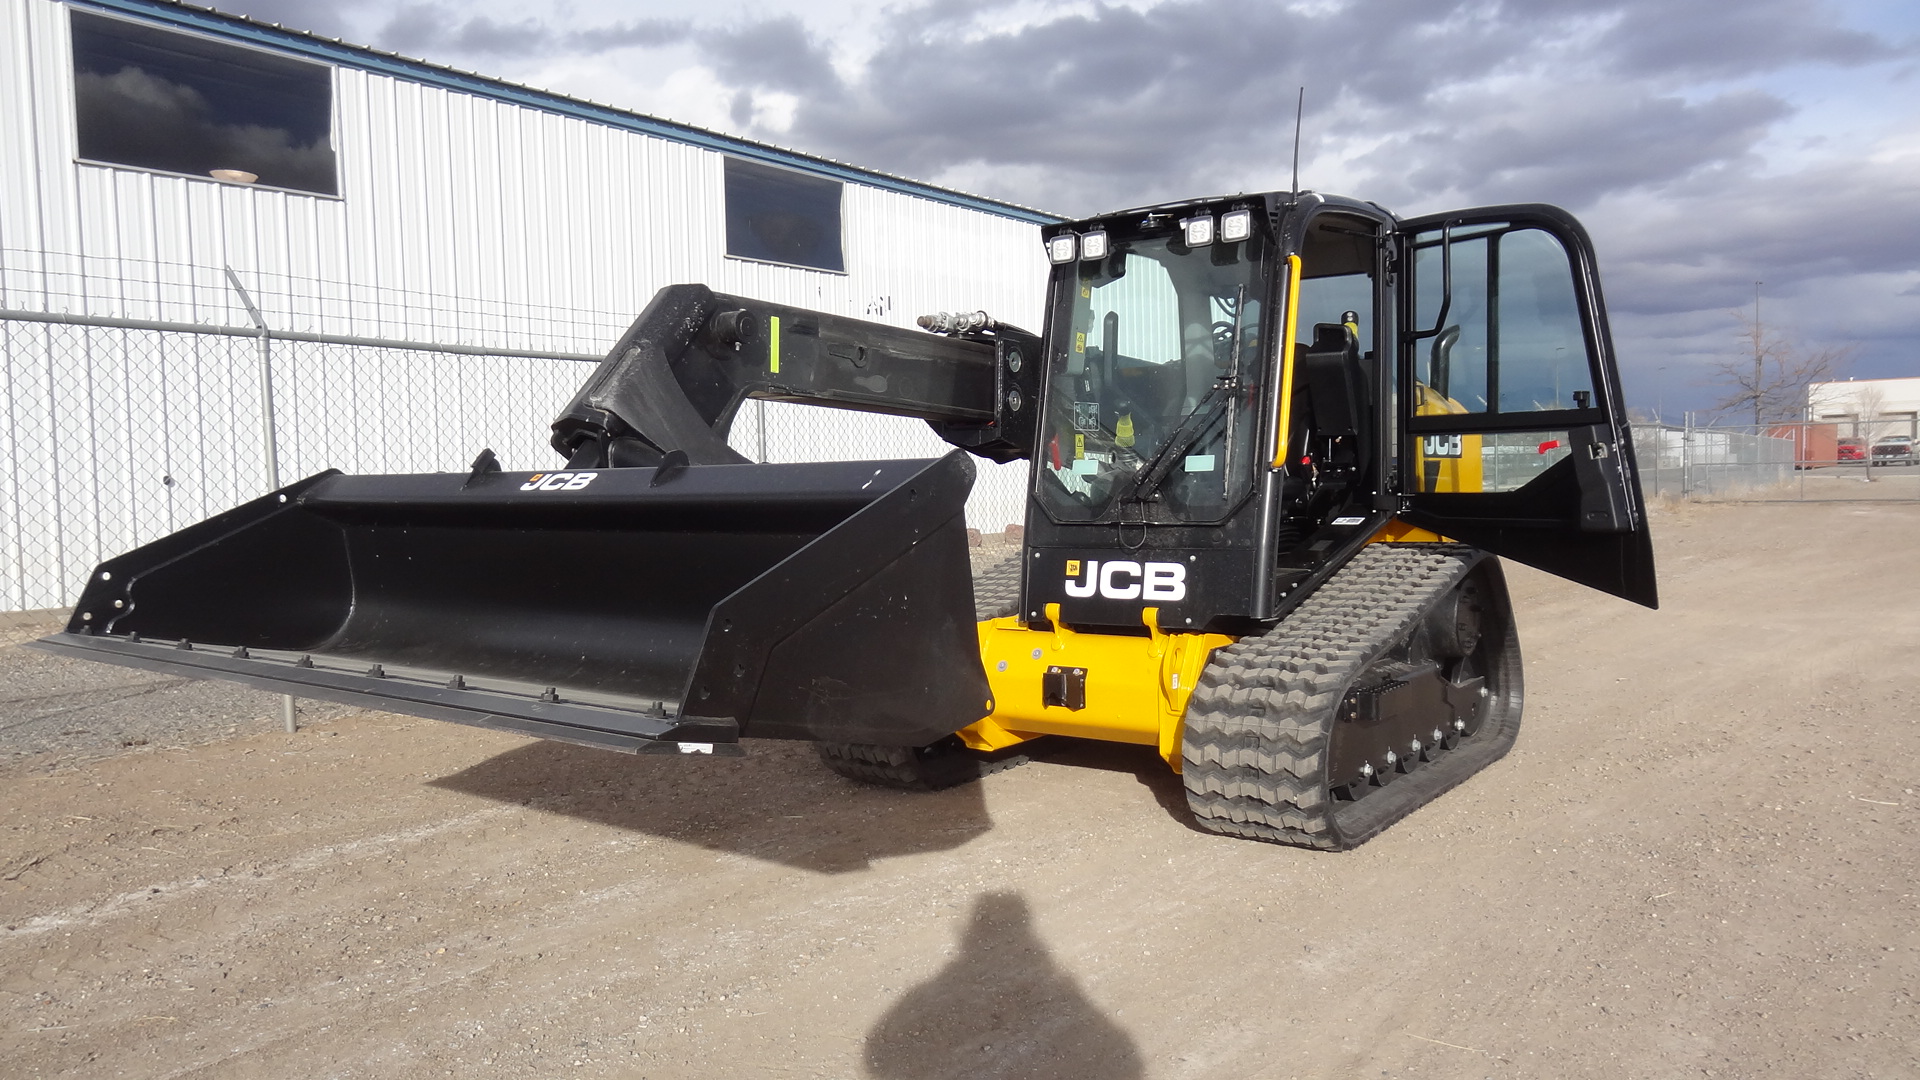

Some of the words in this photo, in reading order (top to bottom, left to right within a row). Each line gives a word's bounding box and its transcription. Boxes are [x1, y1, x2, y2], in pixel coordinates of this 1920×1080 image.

[1424, 434, 1462, 456] JCB
[520, 473, 598, 491] JCB
[1065, 560, 1186, 601] JCB
